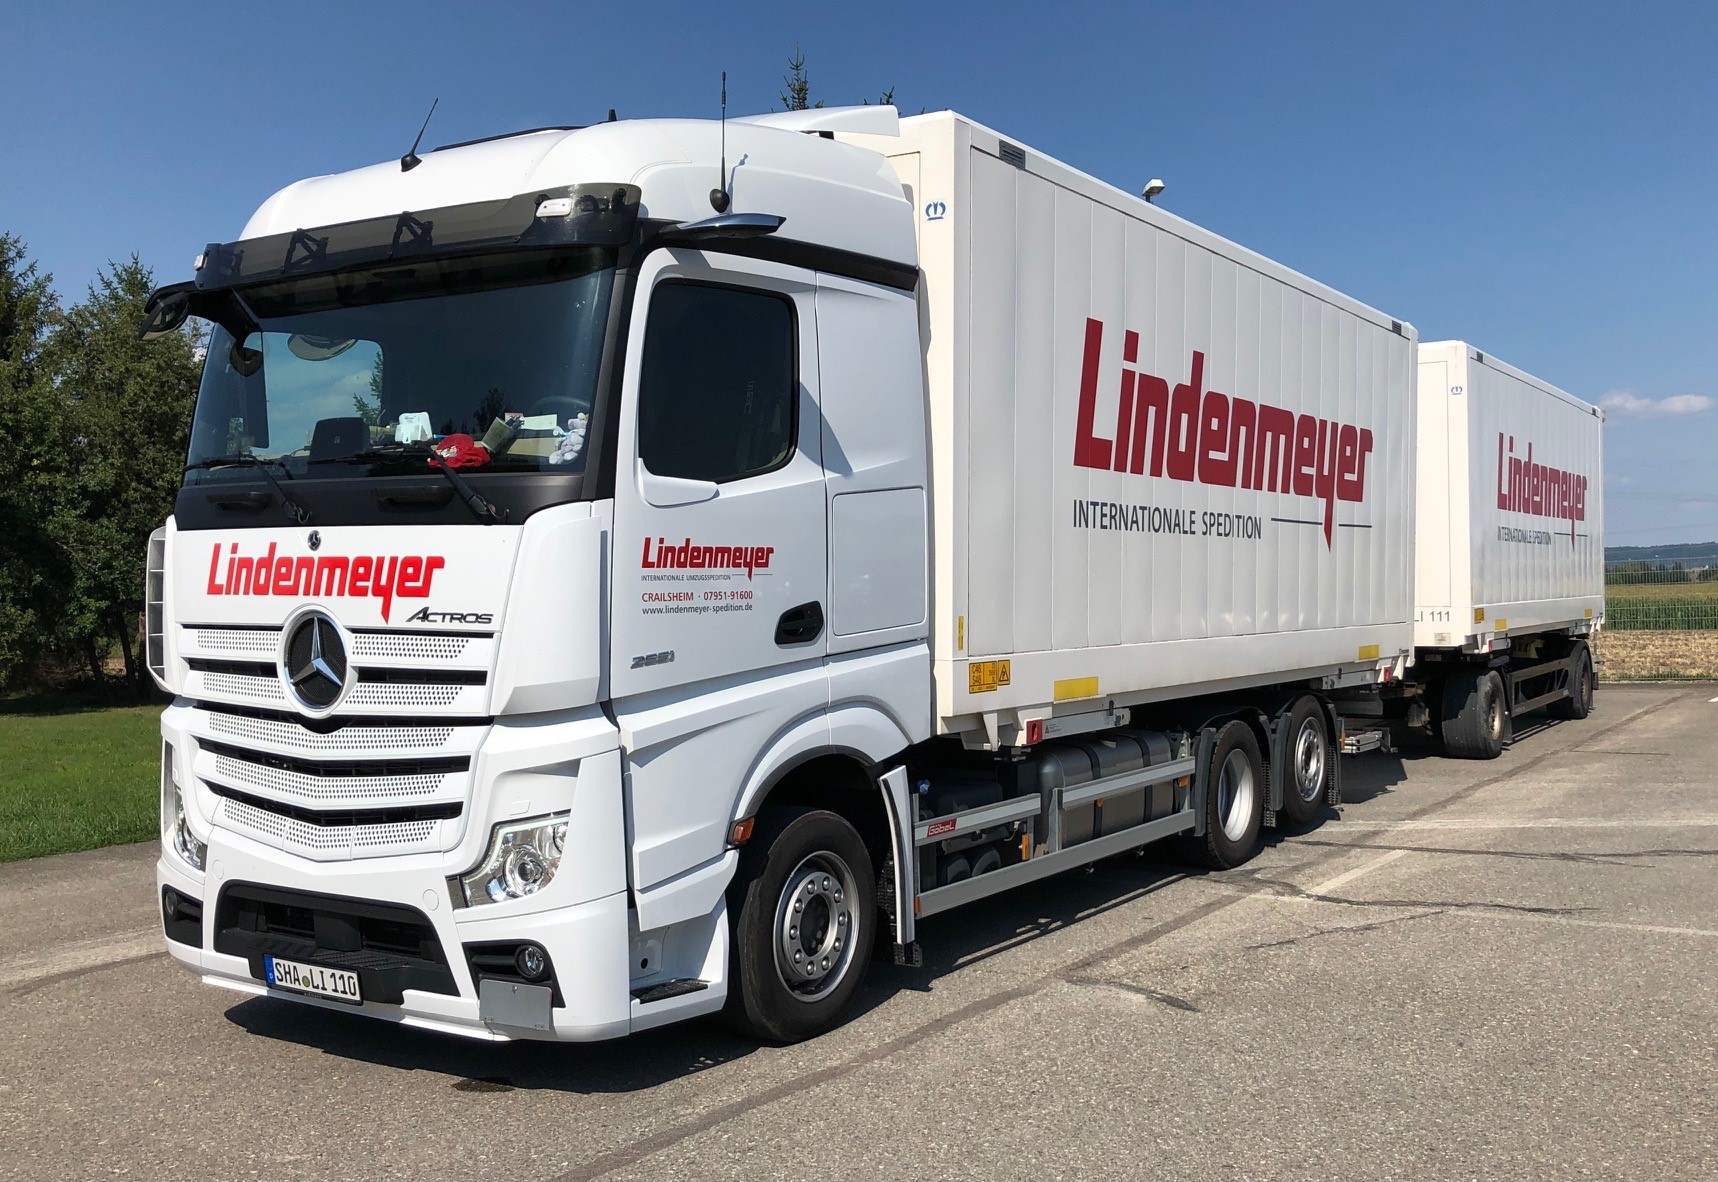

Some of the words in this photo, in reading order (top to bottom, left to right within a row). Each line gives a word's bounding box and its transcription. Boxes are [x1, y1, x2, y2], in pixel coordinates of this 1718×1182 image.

[1073, 317, 1374, 553] Lindenmeyer
[1497, 432, 1587, 550] Lindenmeyer
[1073, 499, 1196, 535] INTERNATIONALE
[1201, 511, 1262, 540] SPEDITION
[641, 537, 774, 582] Lindenmeyer
[207, 542, 445, 625] Lindenmeyer
[641, 574, 685, 582] INTERNATIONALE
[686, 573, 731, 581] UMZUGSSPEDITION
[641, 592, 694, 602] CRAILSHEIM
[703, 590, 753, 600] 07951-91600
[642, 603, 753, 615] www.lindenmeyer-spedition.de
[405, 606, 494, 624] ACTROS
[1429, 611, 1450, 622] 111
[274, 962, 301, 987] SHA
[310, 968, 328, 991] LI
[329, 972, 357, 997] 110
